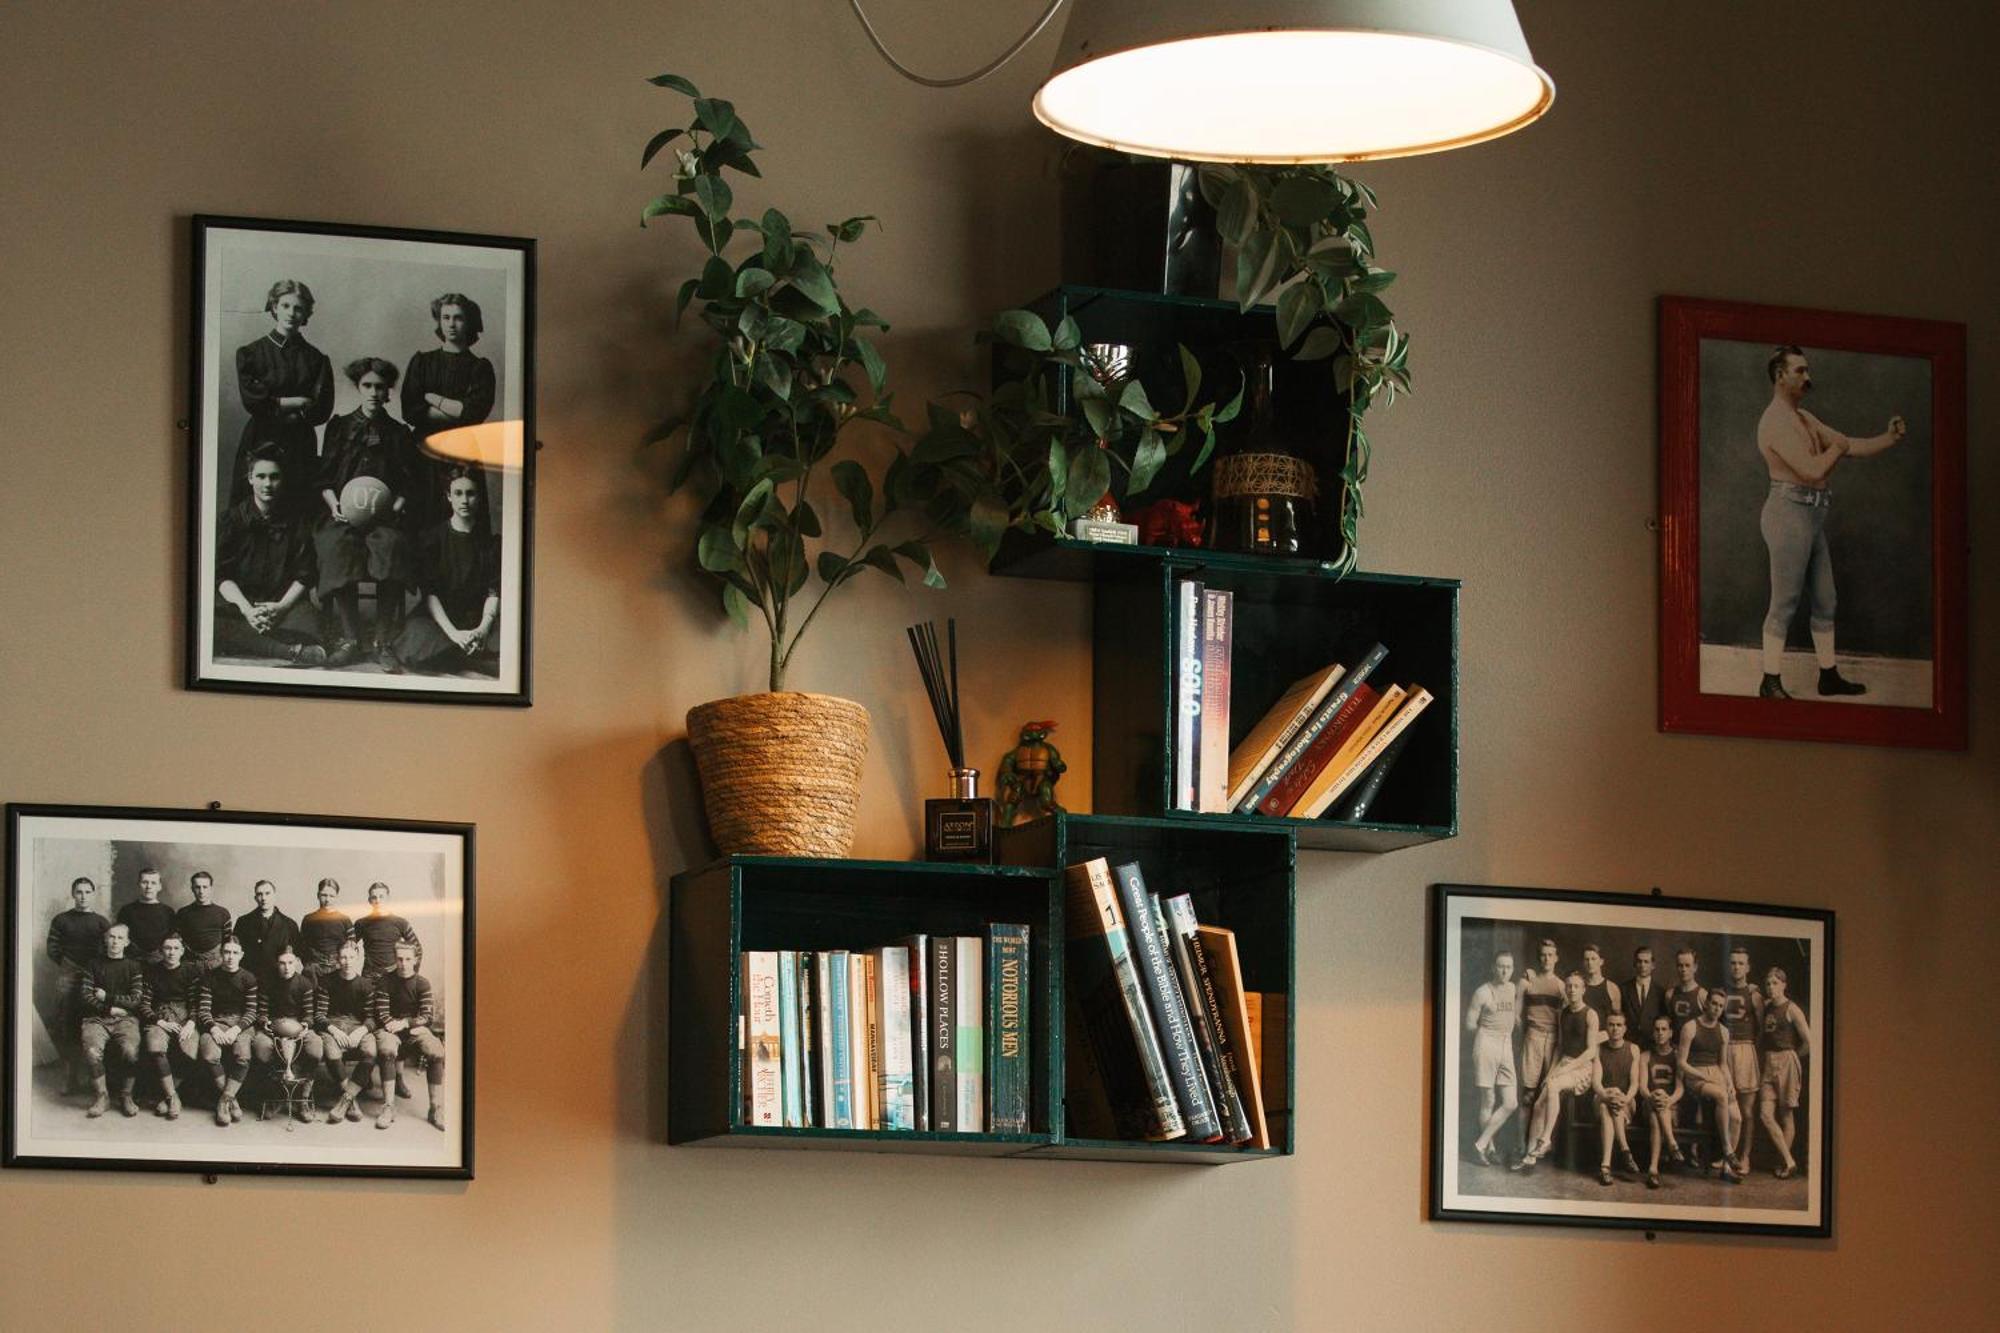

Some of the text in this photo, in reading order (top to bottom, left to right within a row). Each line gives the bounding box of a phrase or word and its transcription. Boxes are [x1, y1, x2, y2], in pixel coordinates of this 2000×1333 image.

[354, 487, 381, 514] 07
[1264, 730, 1315, 789] photography
[1130, 876, 1143, 908] Great
[1105, 903, 1117, 925] 1
[1137, 908, 1154, 943] People
[1148, 943, 1159, 957] of
[1151, 956, 1163, 975] the
[763, 976, 776, 1022] Cometh
[939, 950, 949, 1049] HOLLOW PLACES
[1157, 974, 1171, 1002] Bible
[1002, 959, 1019, 1057] NOTORIOUS MEN
[1164, 1003, 1178, 1023] and
[1170, 1025, 1185, 1050] How
[1178, 1050, 1191, 1076] They
[1185, 1076, 1202, 1107] Lived
